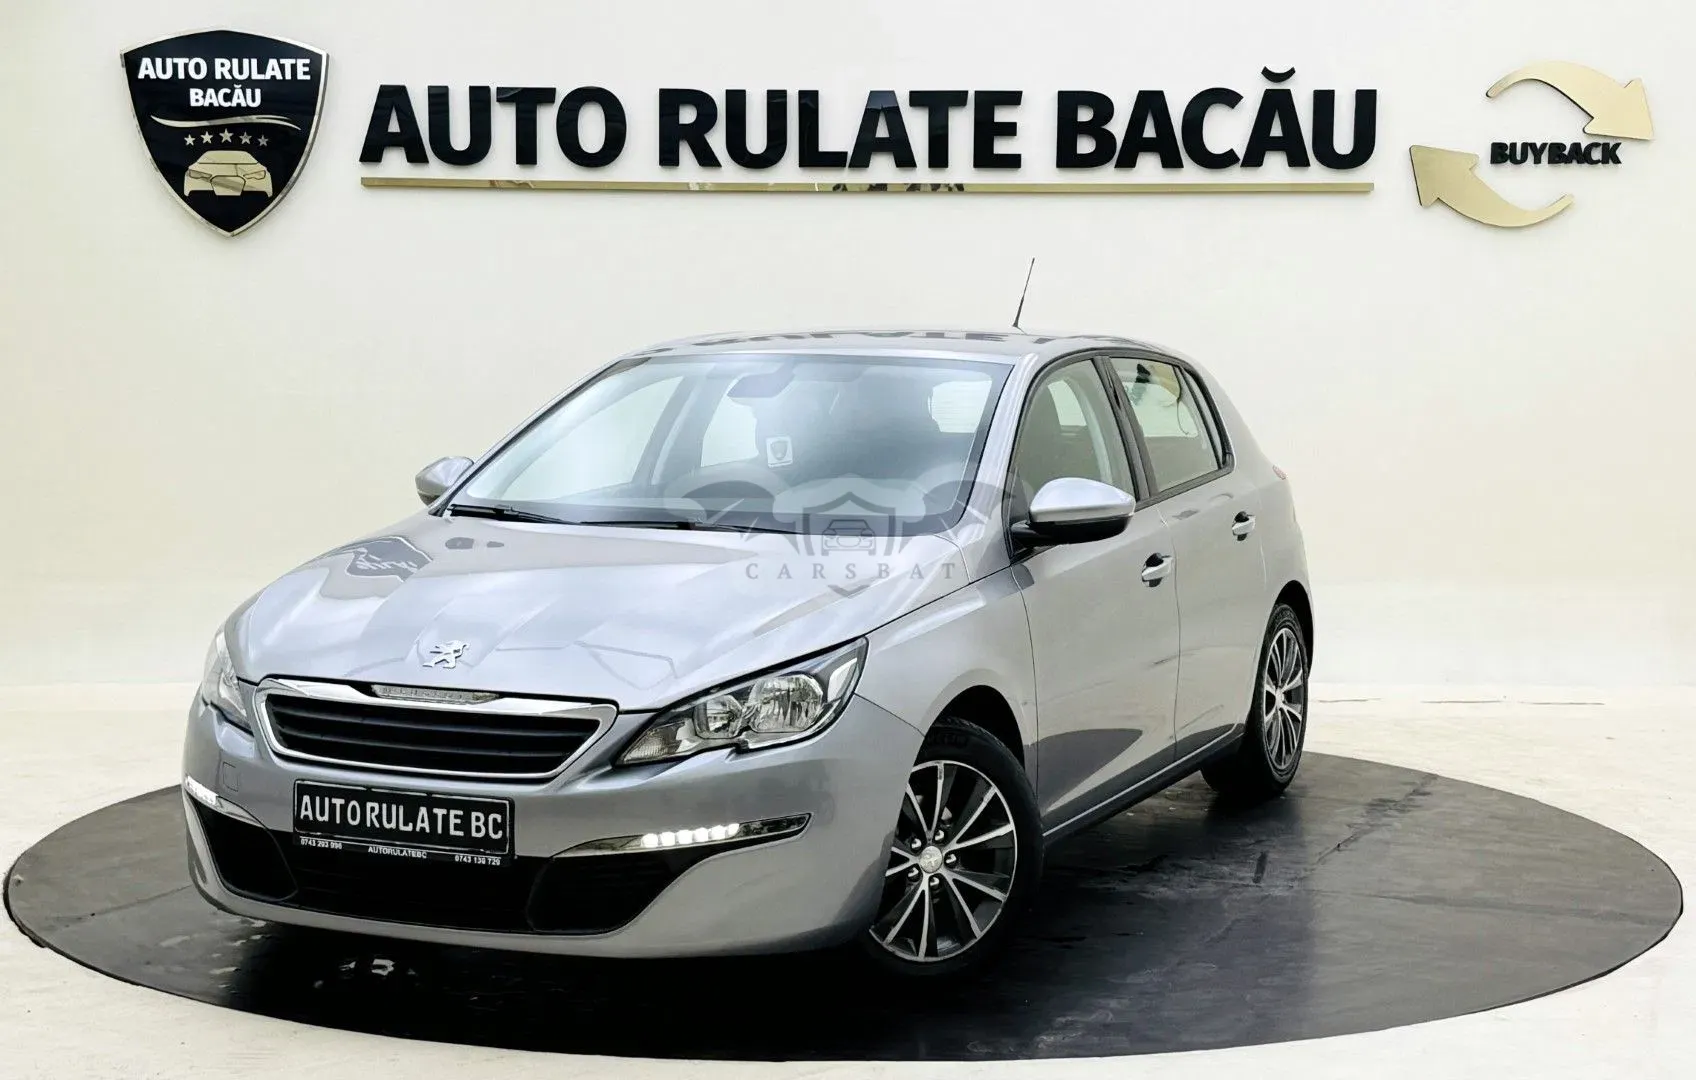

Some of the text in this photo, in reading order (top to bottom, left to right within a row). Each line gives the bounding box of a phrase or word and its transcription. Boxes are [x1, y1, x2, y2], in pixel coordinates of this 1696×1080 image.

[138, 57, 311, 80] AUTO RULATE
[189, 84, 262, 108] BACĂU
[359, 66, 1377, 170] AUTO RULATE BACĂU
[1490, 142, 1622, 166] BUYBACK
[300, 794, 503, 840] AUTO RULATE BC
